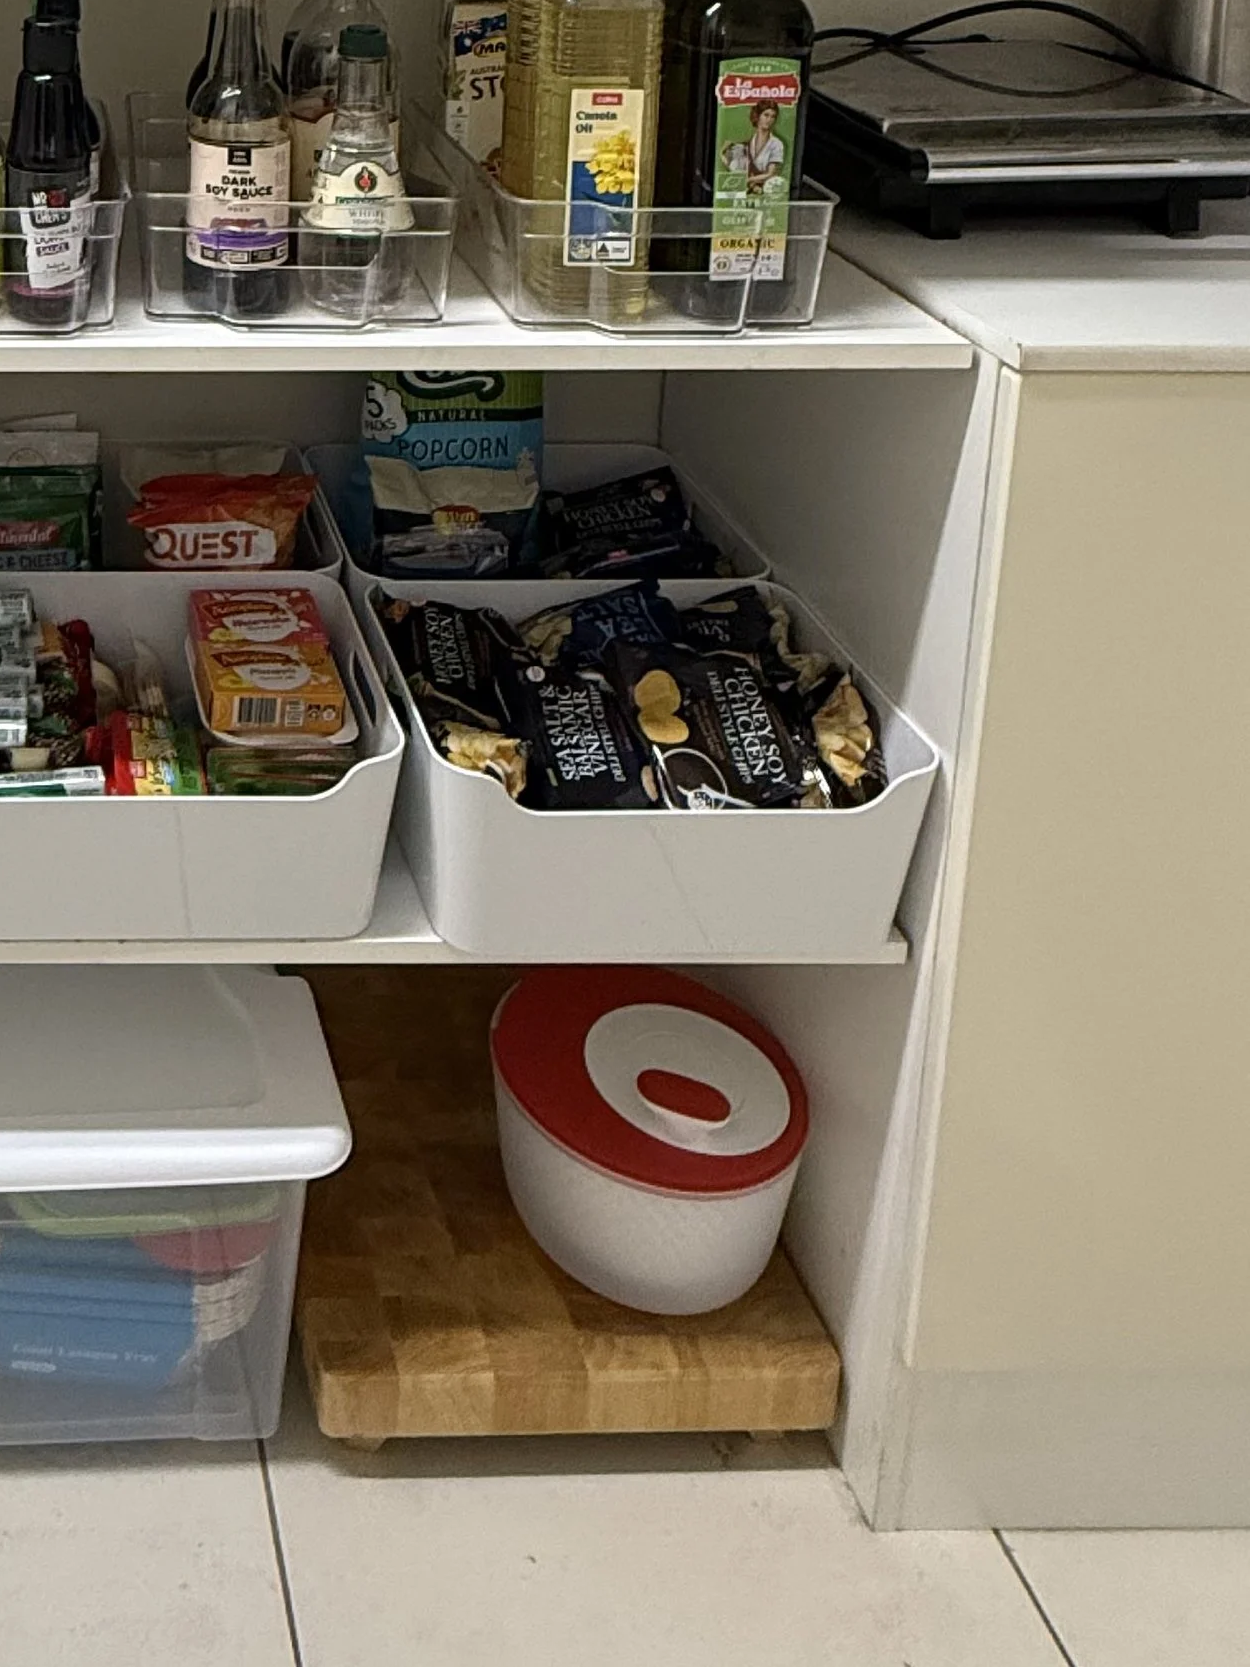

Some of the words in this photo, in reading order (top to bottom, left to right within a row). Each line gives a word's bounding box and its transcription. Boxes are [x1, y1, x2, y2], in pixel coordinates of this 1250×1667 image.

[722, 84, 797, 101] Española
[734, 77, 753, 89] La
[575, 110, 618, 122] Canola
[575, 122, 593, 134] Oil
[205, 184, 230, 195] SOY
[231, 185, 274, 200] SAUCE
[221, 175, 257, 187] DARK
[365, 385, 384, 418] 5
[364, 417, 398, 433] PACKS
[417, 409, 488, 423] NATURAL
[399, 436, 510, 462] POPCORN
[151, 527, 260, 561] QUEST
[439, 614, 464, 679] CHICKEN
[538, 684, 555, 698] &
[543, 703, 564, 746] SALT
[555, 685, 596, 779] BALSAMIC
[572, 689, 609, 775] VINEGAR
[724, 677, 769, 778] CHICKEN
[735, 667, 776, 739] HONEY
[763, 740, 791, 785] SOY
[556, 747, 579, 781] SEA
